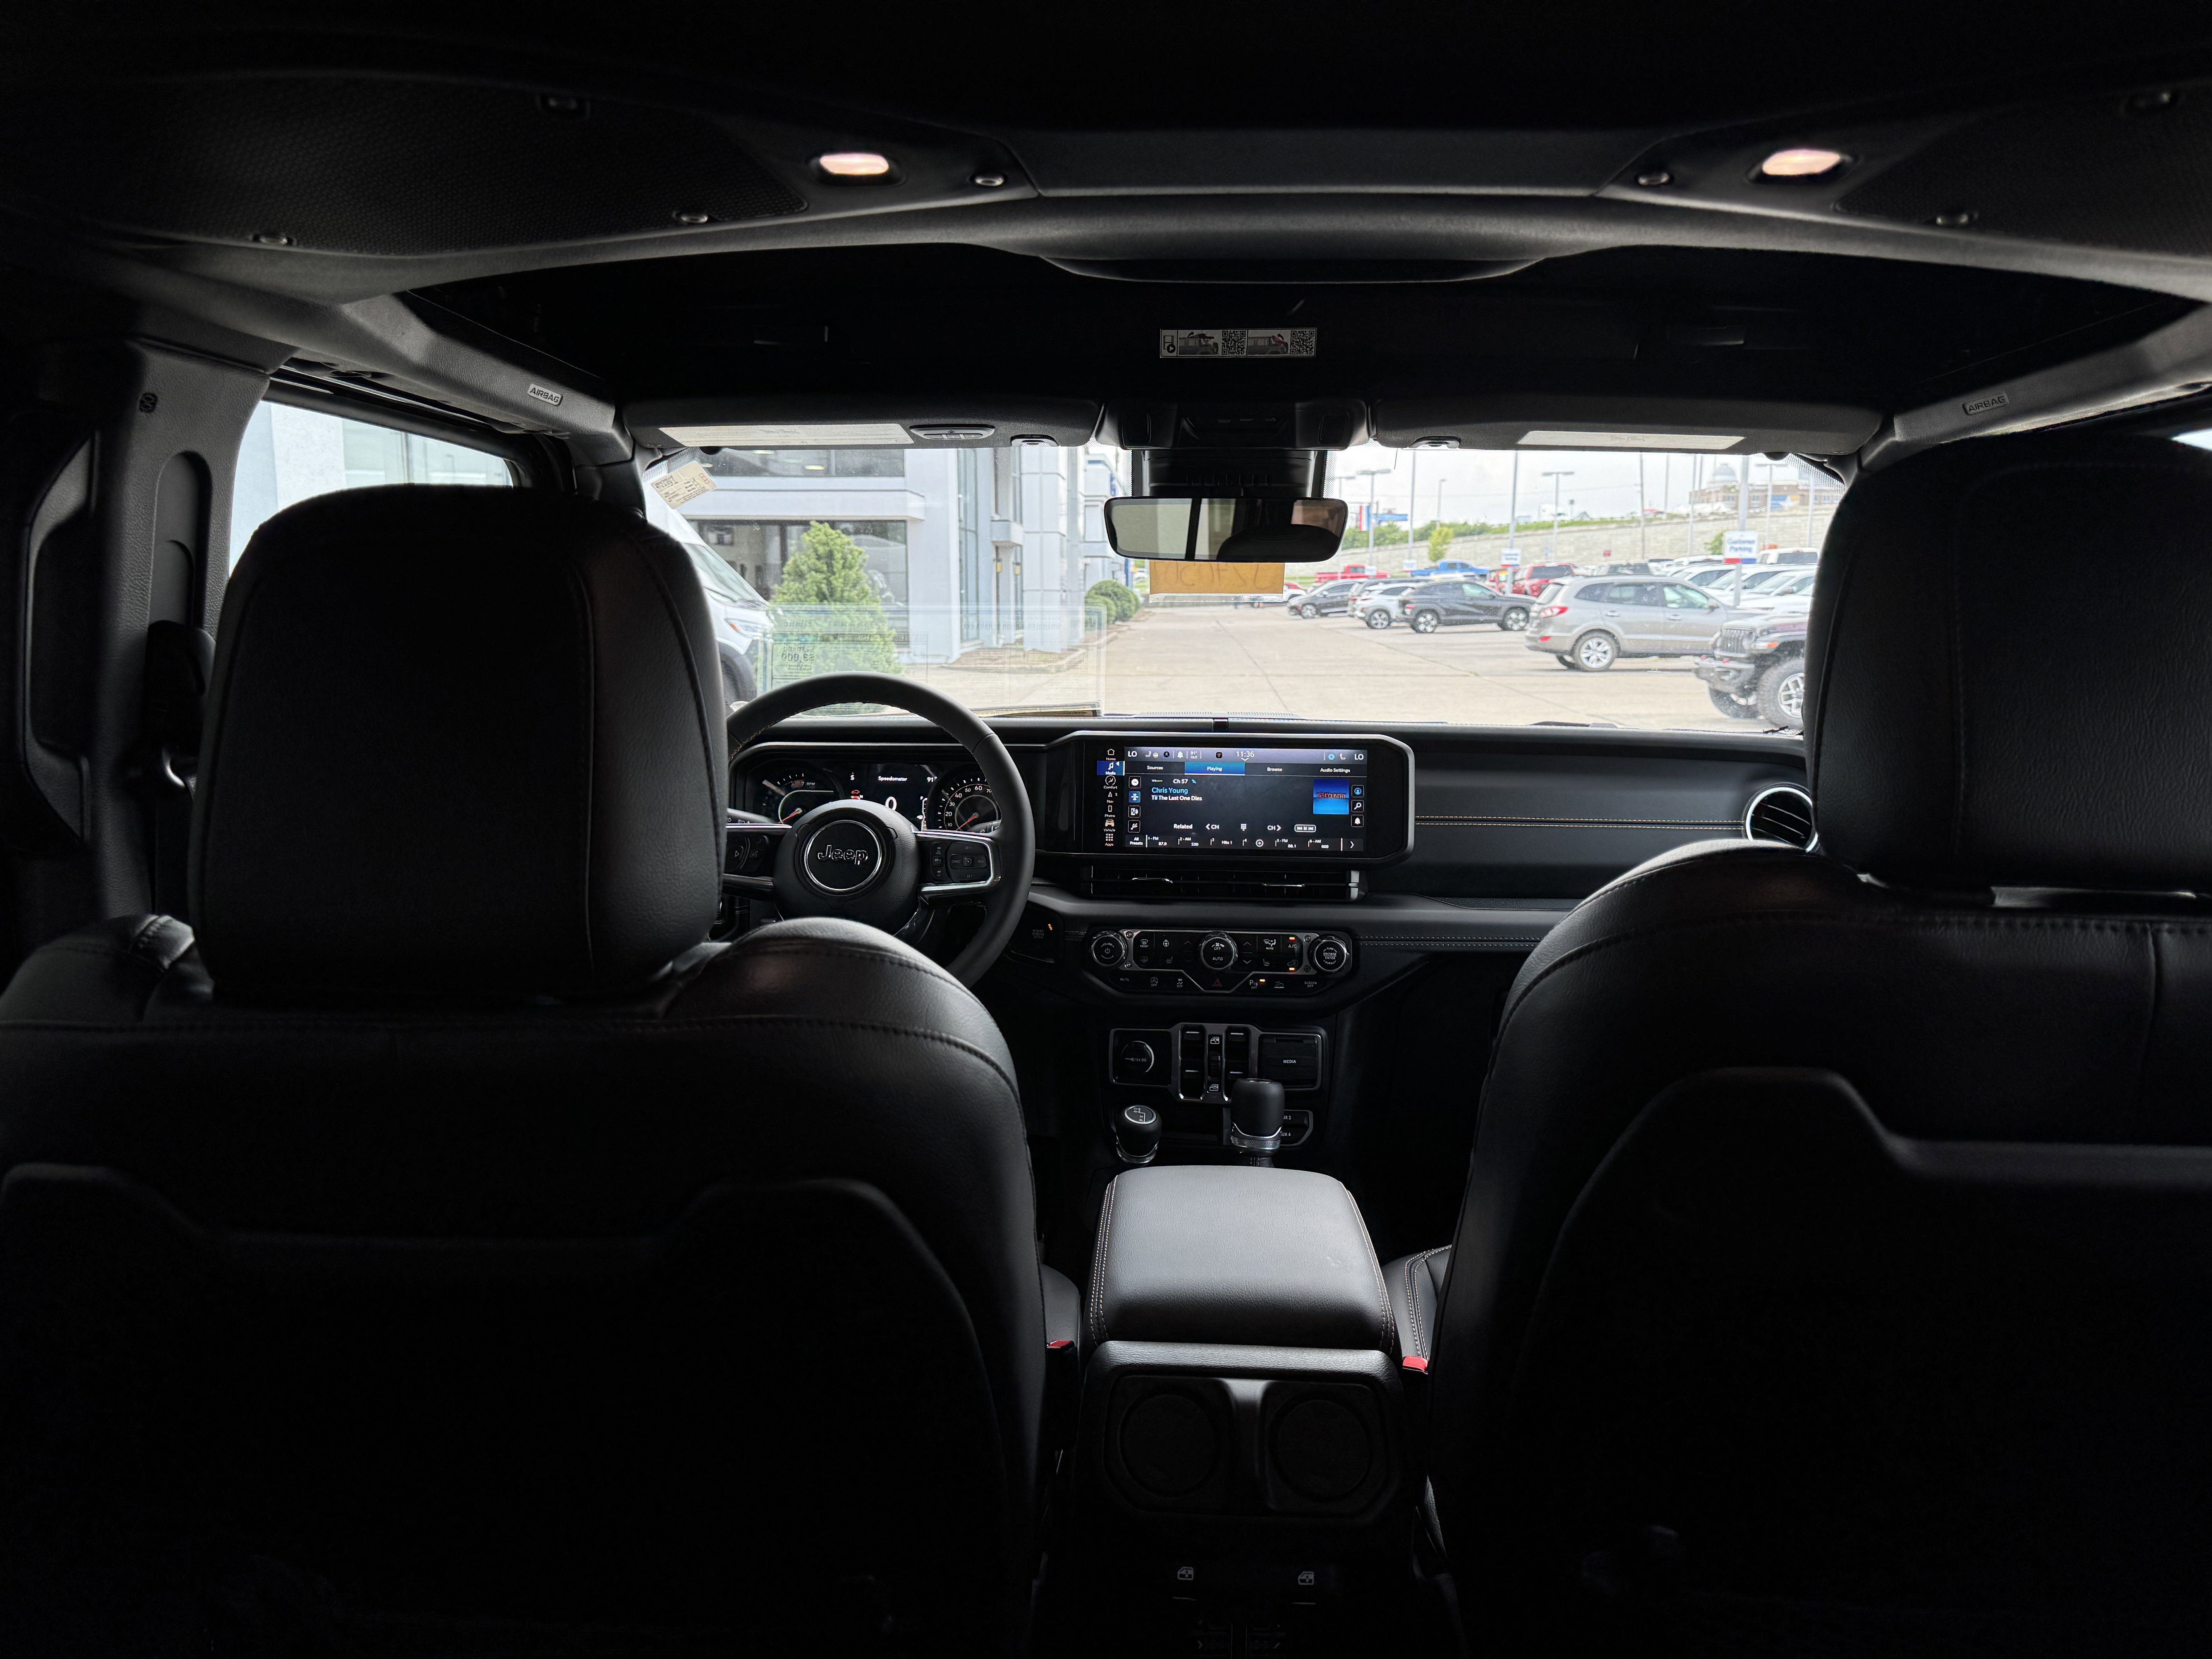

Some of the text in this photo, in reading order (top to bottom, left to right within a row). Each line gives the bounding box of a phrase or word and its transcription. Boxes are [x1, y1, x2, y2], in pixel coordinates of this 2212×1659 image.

[530, 387, 559, 403] AIRBAG
[1968, 396, 2005, 412] AIRBAG
[885, 796, 897, 811] 0
[817, 845, 868, 865] Jeep
